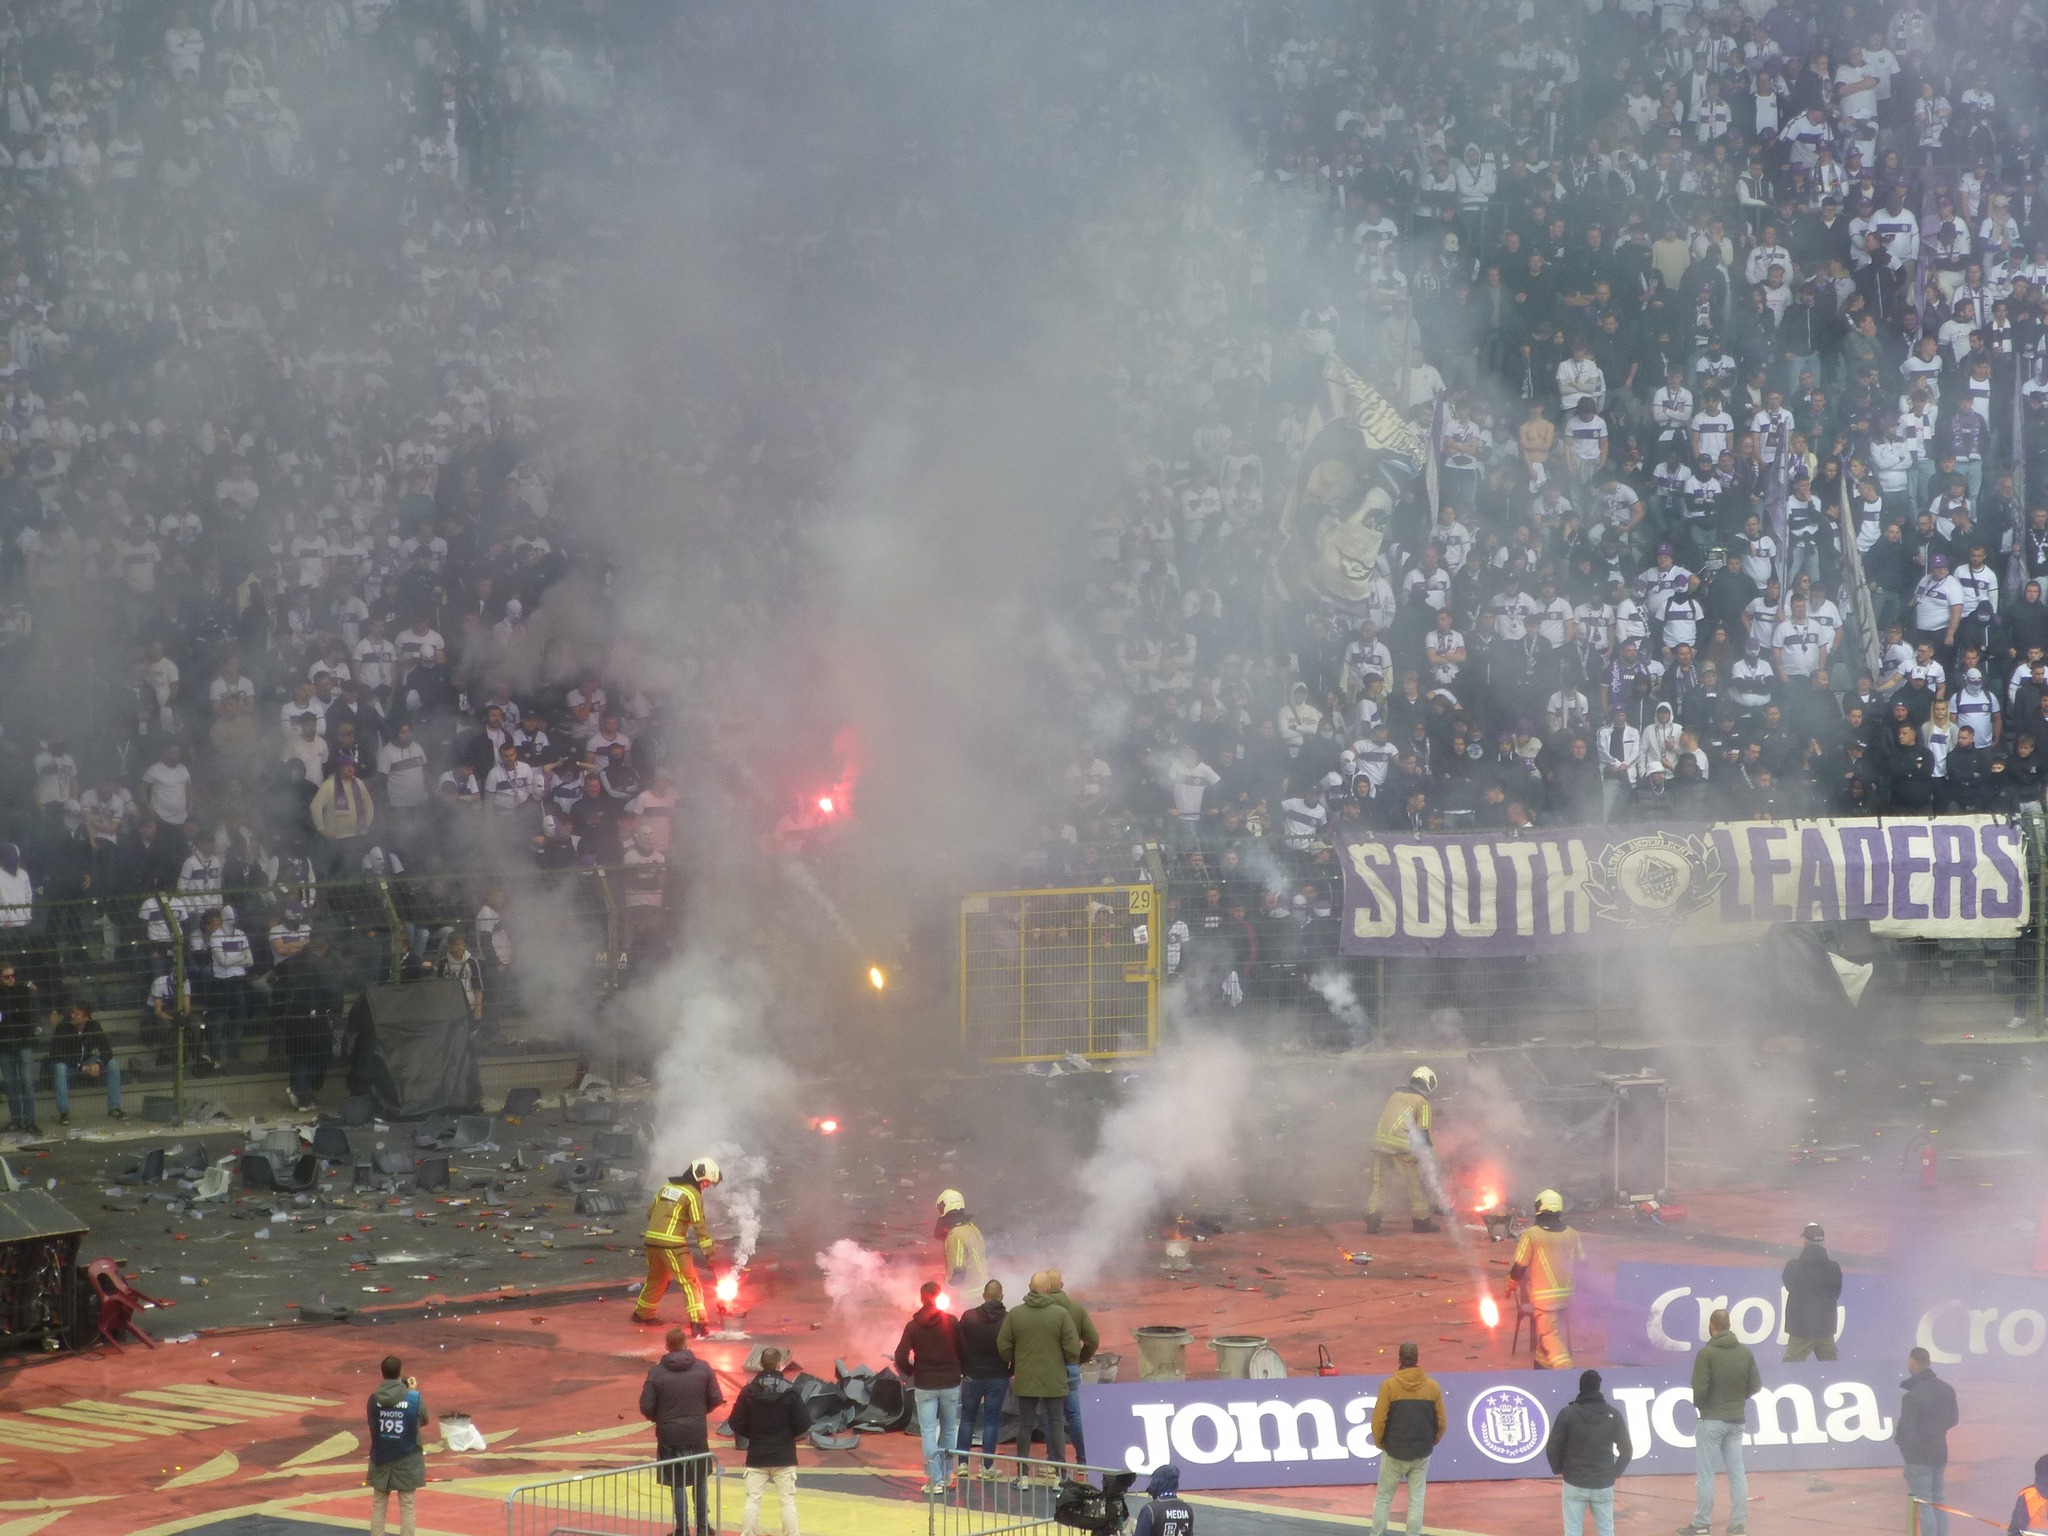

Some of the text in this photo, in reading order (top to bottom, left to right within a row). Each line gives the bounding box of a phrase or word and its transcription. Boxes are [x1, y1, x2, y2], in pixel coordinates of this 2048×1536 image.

[1348, 824, 2023, 938] SOUTH LEADERS
[1130, 890, 1150, 909] 29
[379, 1419, 404, 1434] 195
[1166, 1510, 1189, 1519] MEDIA
